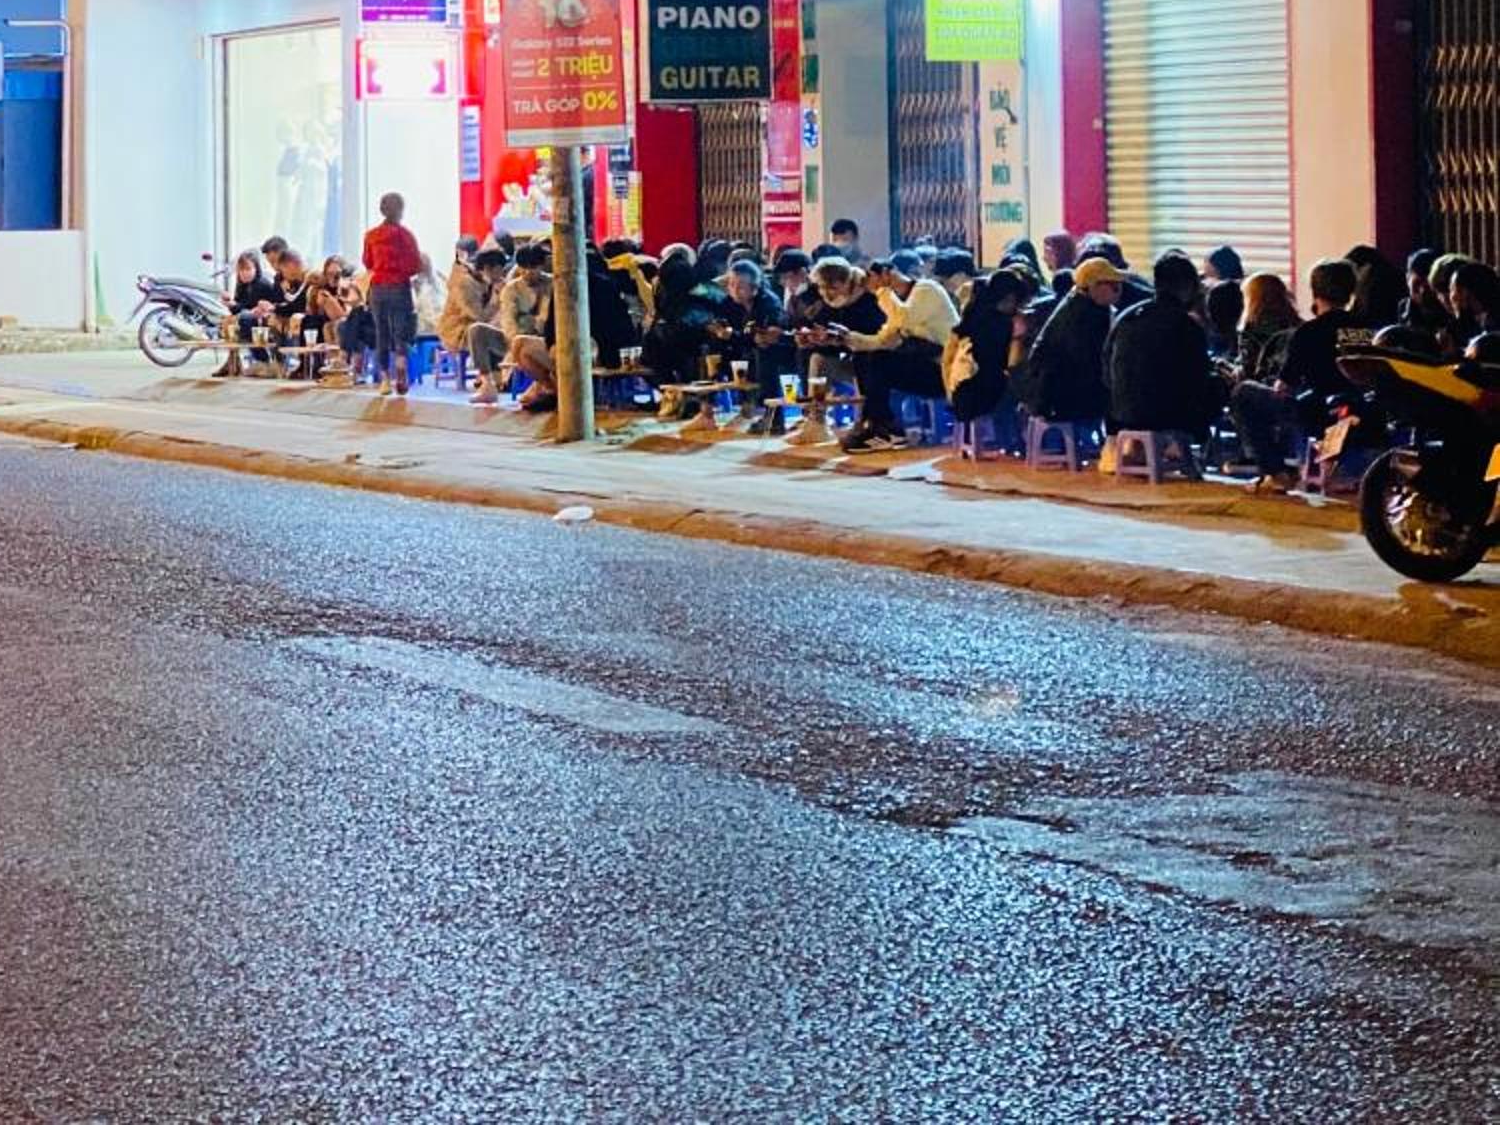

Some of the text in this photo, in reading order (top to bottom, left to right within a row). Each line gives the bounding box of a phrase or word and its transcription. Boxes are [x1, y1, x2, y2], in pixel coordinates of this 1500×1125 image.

[656, 5, 761, 30] PIANO
[537, 58, 550, 76] 2
[555, 49, 614, 81] TRIỆU
[660, 65, 761, 90] GUITAR
[583, 90, 619, 111] 0%
